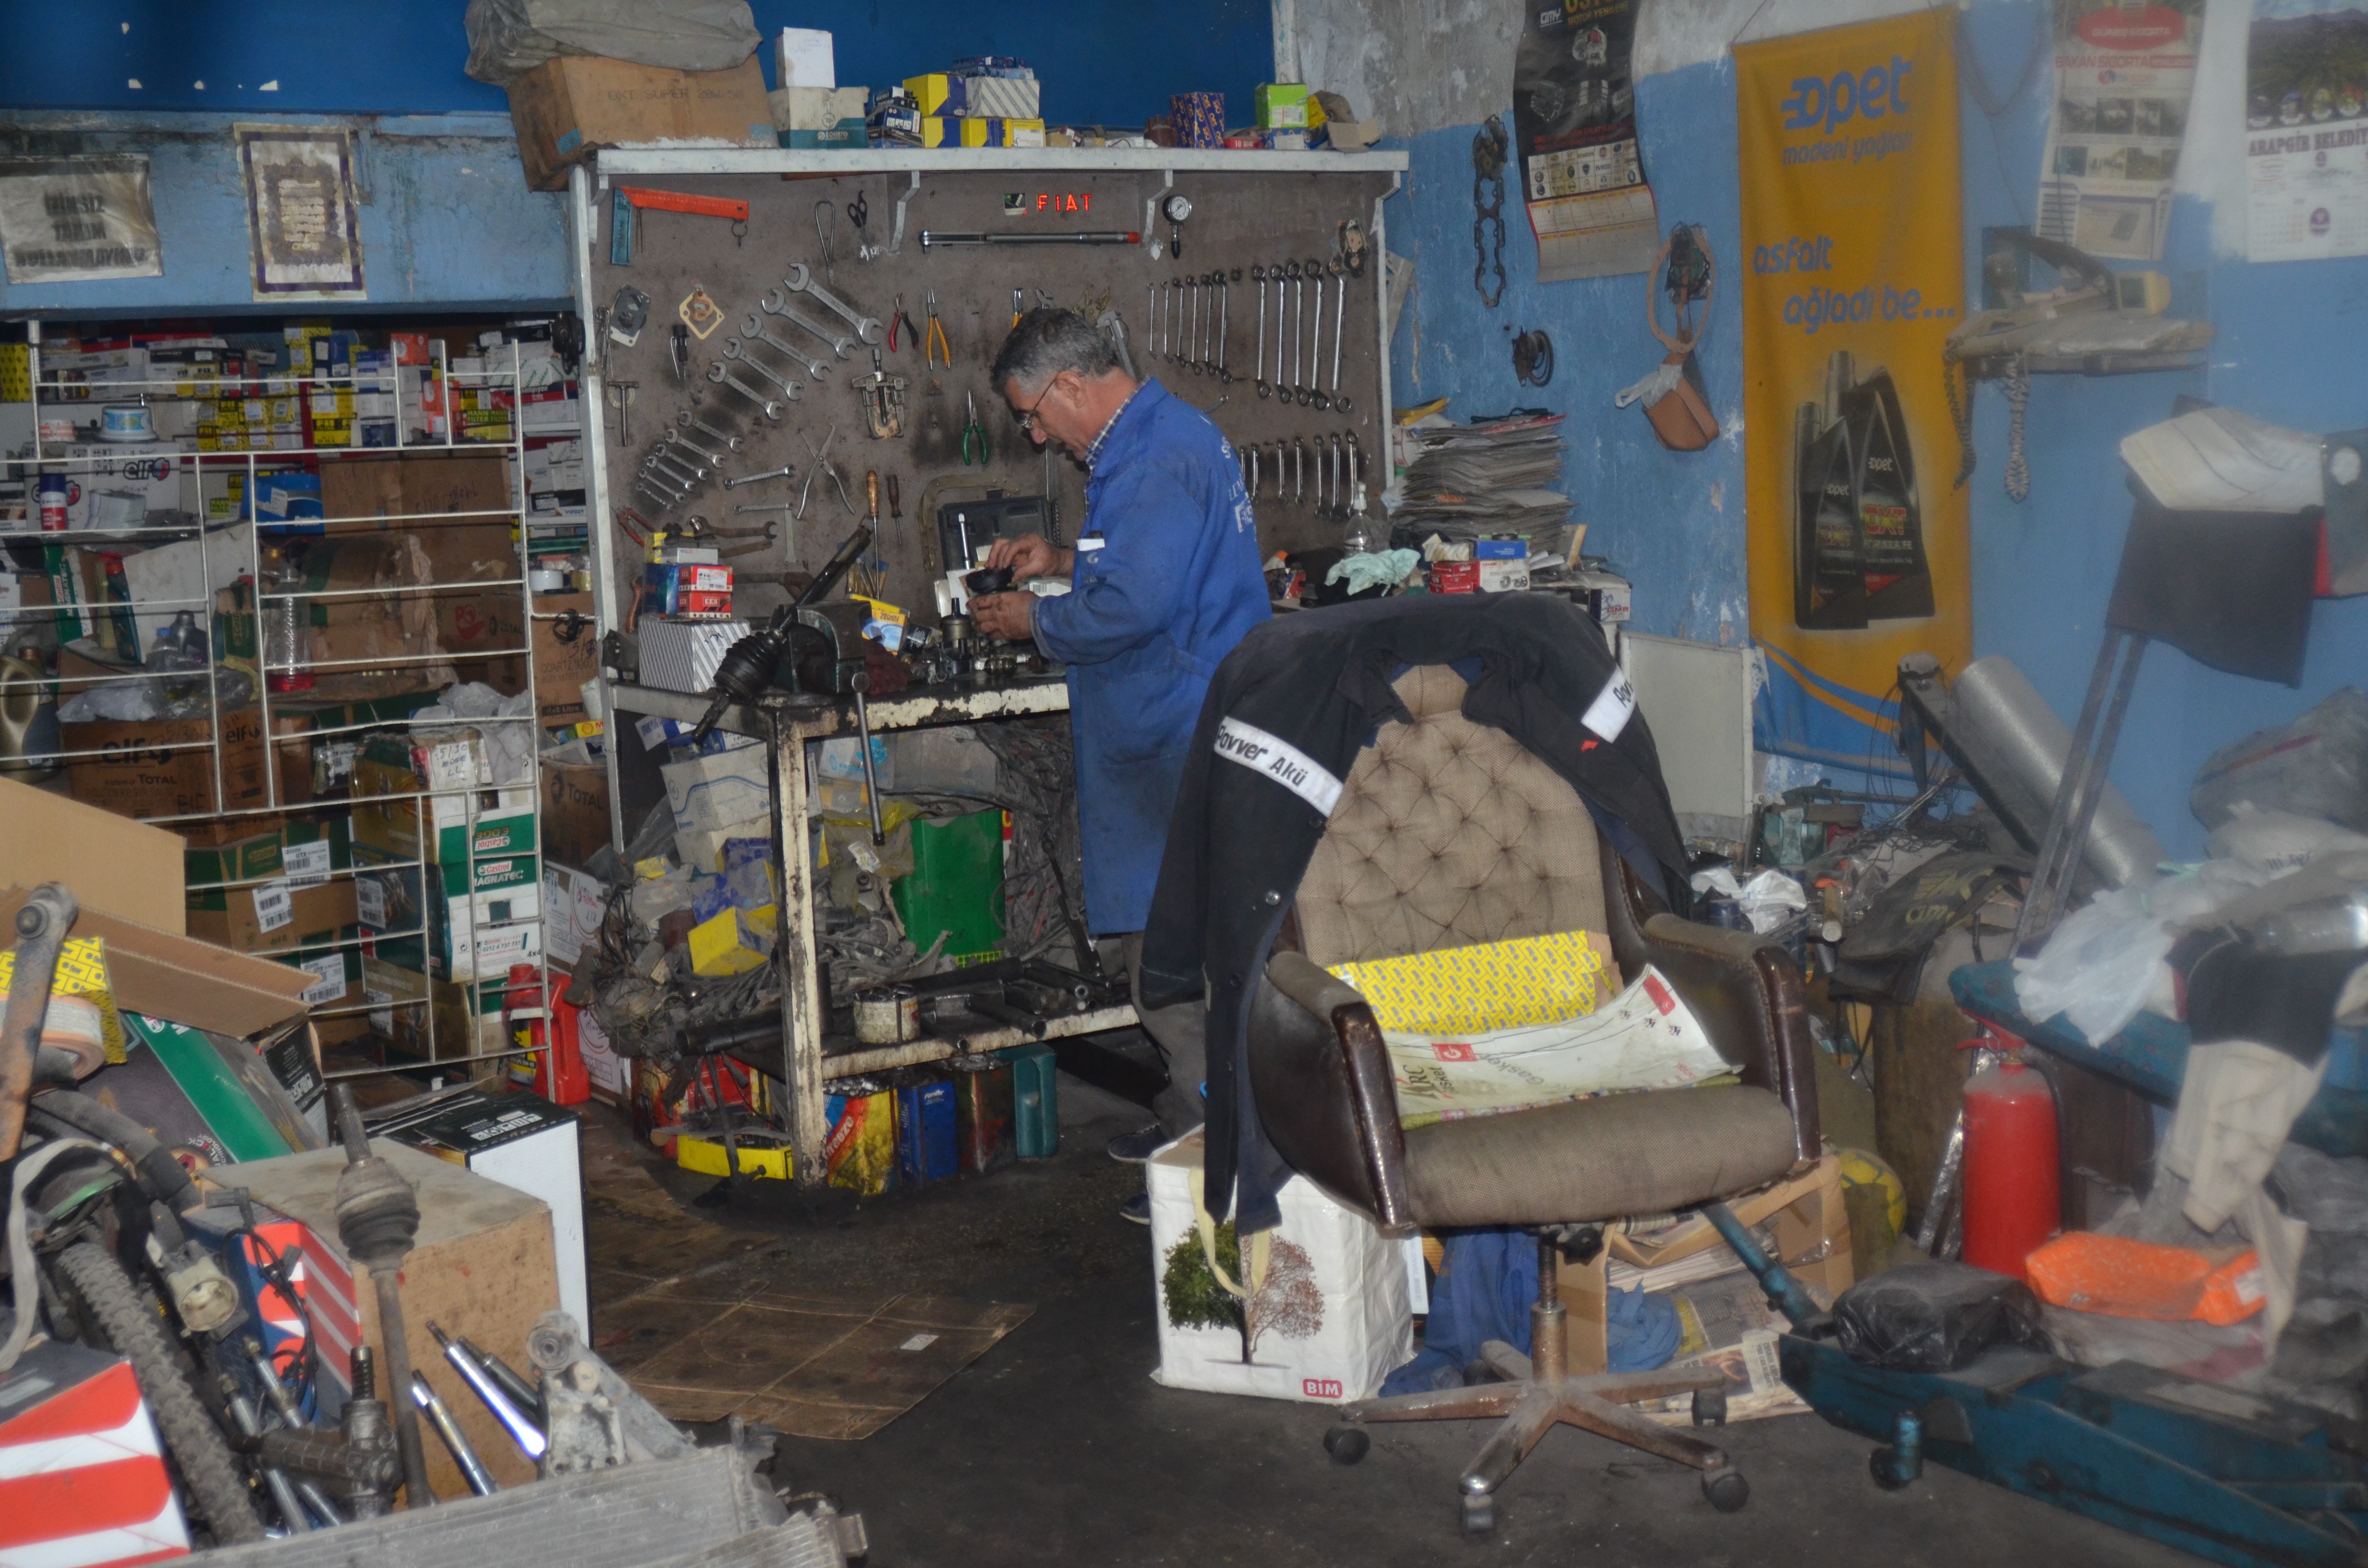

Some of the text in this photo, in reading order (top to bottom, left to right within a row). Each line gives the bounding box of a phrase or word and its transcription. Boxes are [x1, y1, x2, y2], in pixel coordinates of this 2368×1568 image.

[1782, 136, 1850, 161] madeni
[1037, 194, 1092, 212] FIAT
[1753, 235, 1834, 275] asfalt
[1783, 285, 1873, 335] ağladı
[123, 459, 156, 480] elf
[225, 727, 249, 744] elf
[101, 738, 146, 764] elf
[442, 756, 466, 768] EDGE
[137, 773, 178, 784] TOTAL
[1269, 757, 1308, 787] Akü
[567, 782, 604, 811] TOTAL
[475, 827, 510, 840] EDGE
[477, 837, 502, 850] Castrol
[485, 863, 510, 874] Castrol
[582, 895, 598, 909] TOTAL
[527, 949, 541, 957] 4x4
